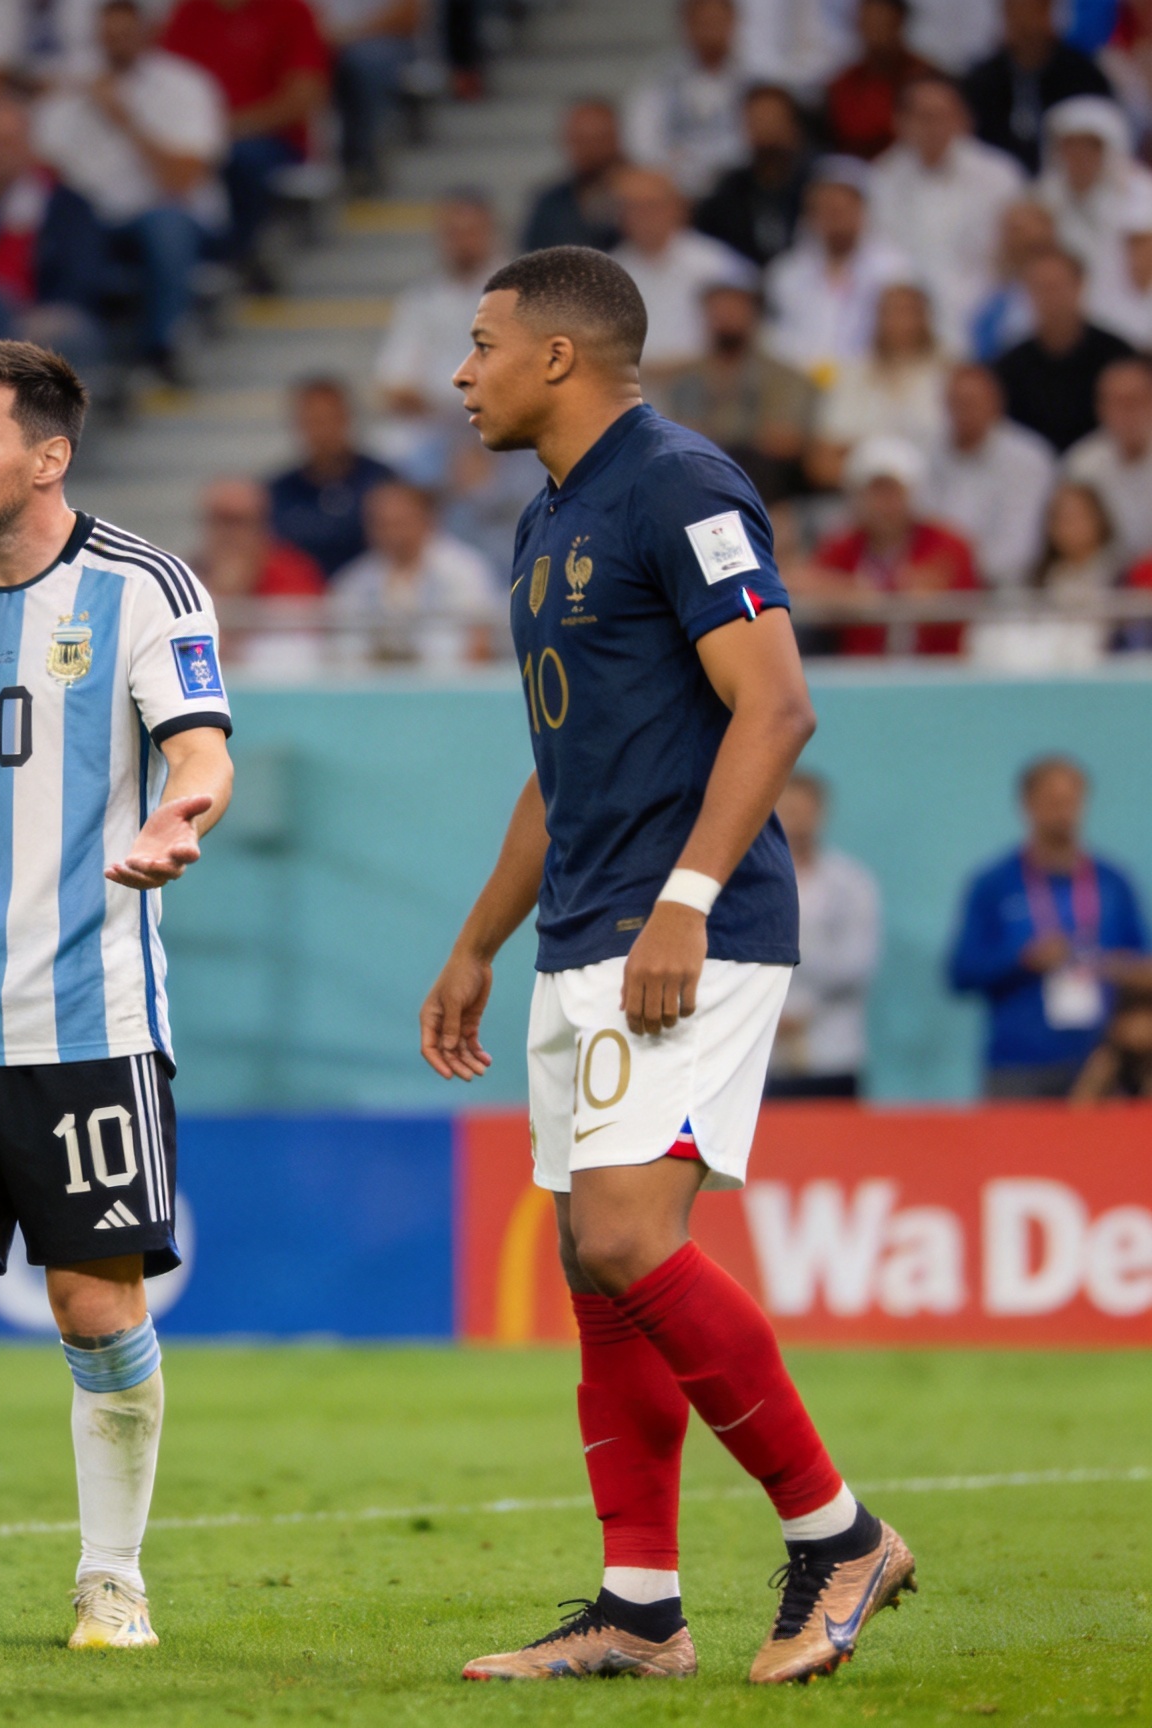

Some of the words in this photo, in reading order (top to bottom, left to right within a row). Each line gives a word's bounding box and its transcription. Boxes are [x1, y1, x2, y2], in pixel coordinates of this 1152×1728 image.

[522, 646, 569, 735] 10
[53, 1104, 138, 1194] 10
[741, 1177, 968, 1317] Wa
[981, 1176, 1152, 1318] De
